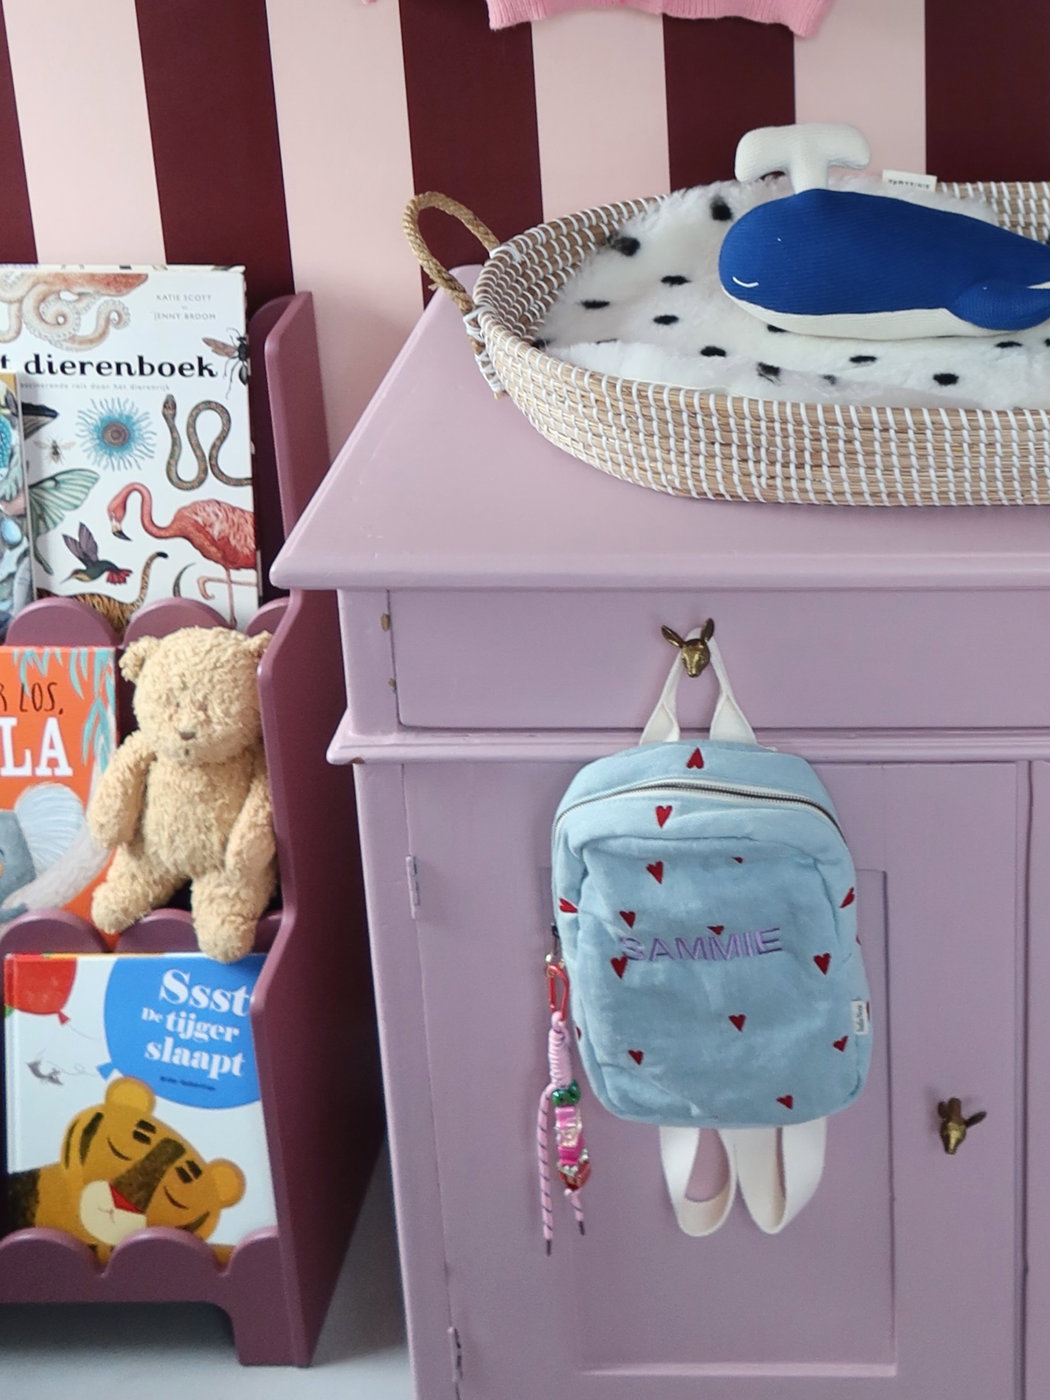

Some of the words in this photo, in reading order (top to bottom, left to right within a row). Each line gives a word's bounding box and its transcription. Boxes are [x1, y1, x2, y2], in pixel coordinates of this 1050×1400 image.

[153, 312, 180, 321] JENNY
[24, 353, 218, 378] dierenboek
[618, 927, 783, 962] SAMMIE
[158, 968, 250, 1018] Ssst
[141, 1007, 163, 1022] De
[165, 1010, 240, 1043] tijger
[144, 1036, 245, 1080] slaapt
